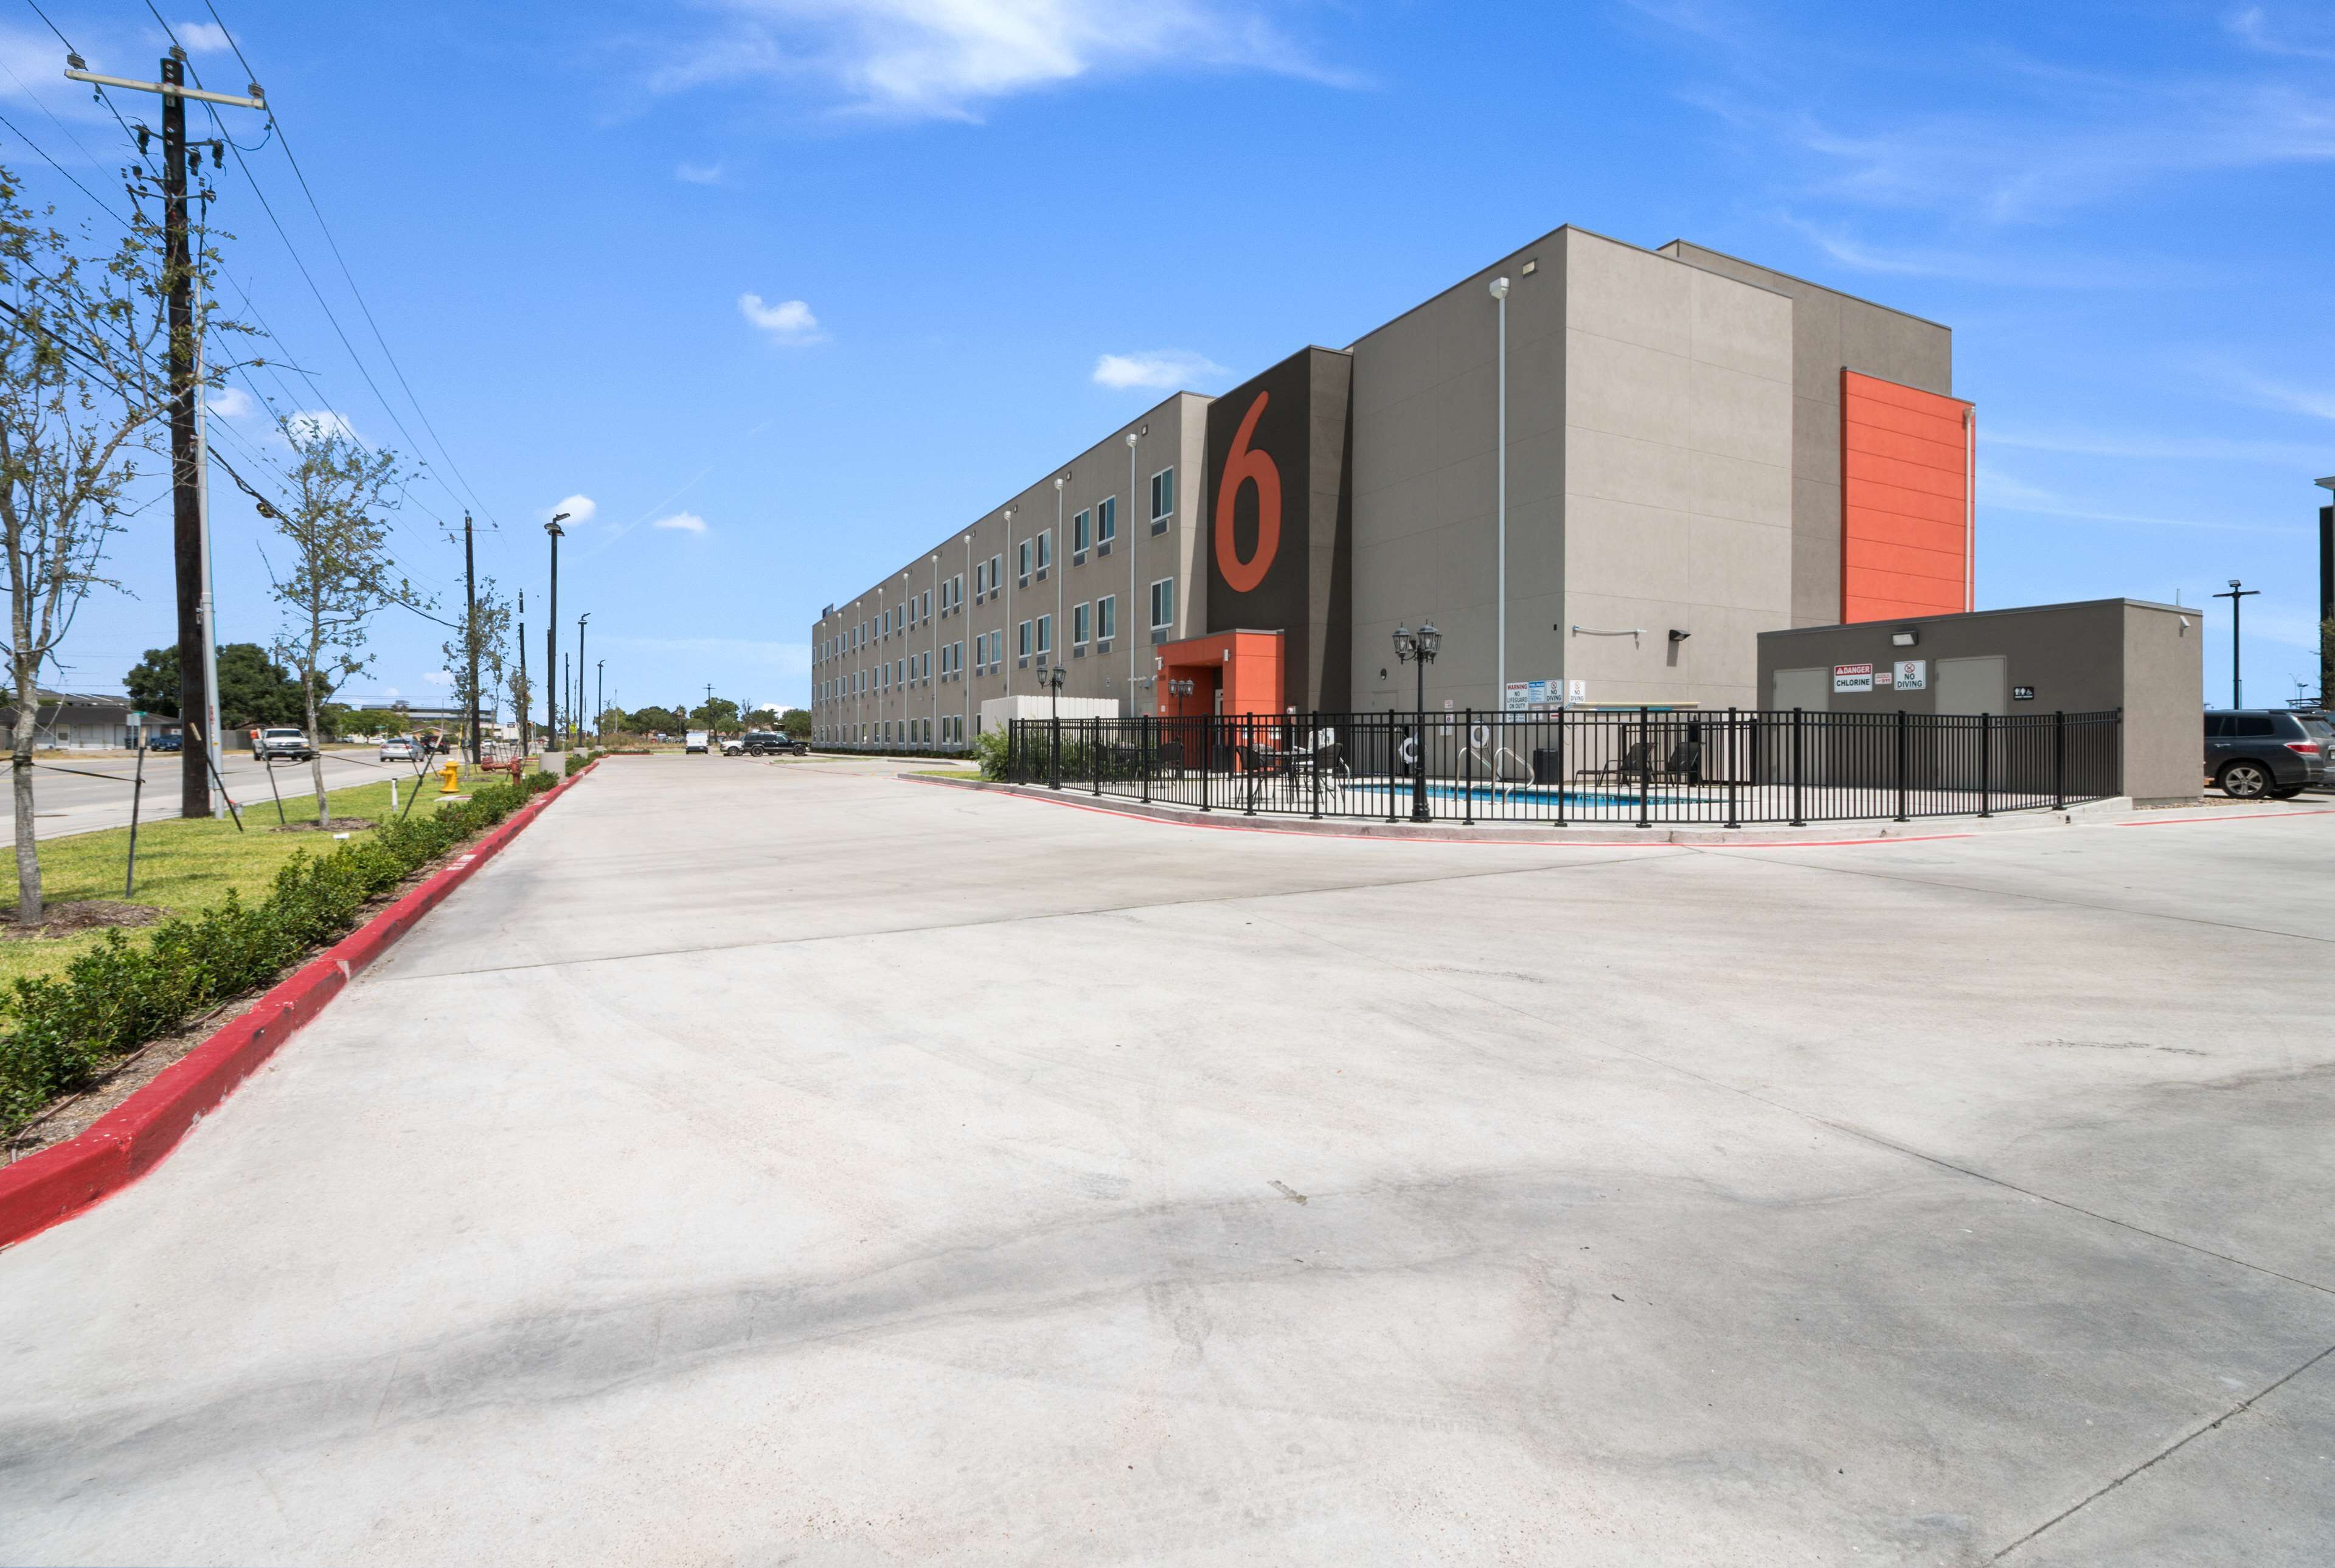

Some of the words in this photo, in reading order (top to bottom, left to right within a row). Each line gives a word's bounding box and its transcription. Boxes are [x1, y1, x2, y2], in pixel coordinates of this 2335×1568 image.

[1215, 390, 1282, 592] 6
[1844, 666, 1870, 675] DANGER
[1836, 678, 1870, 687] CHLORINE
